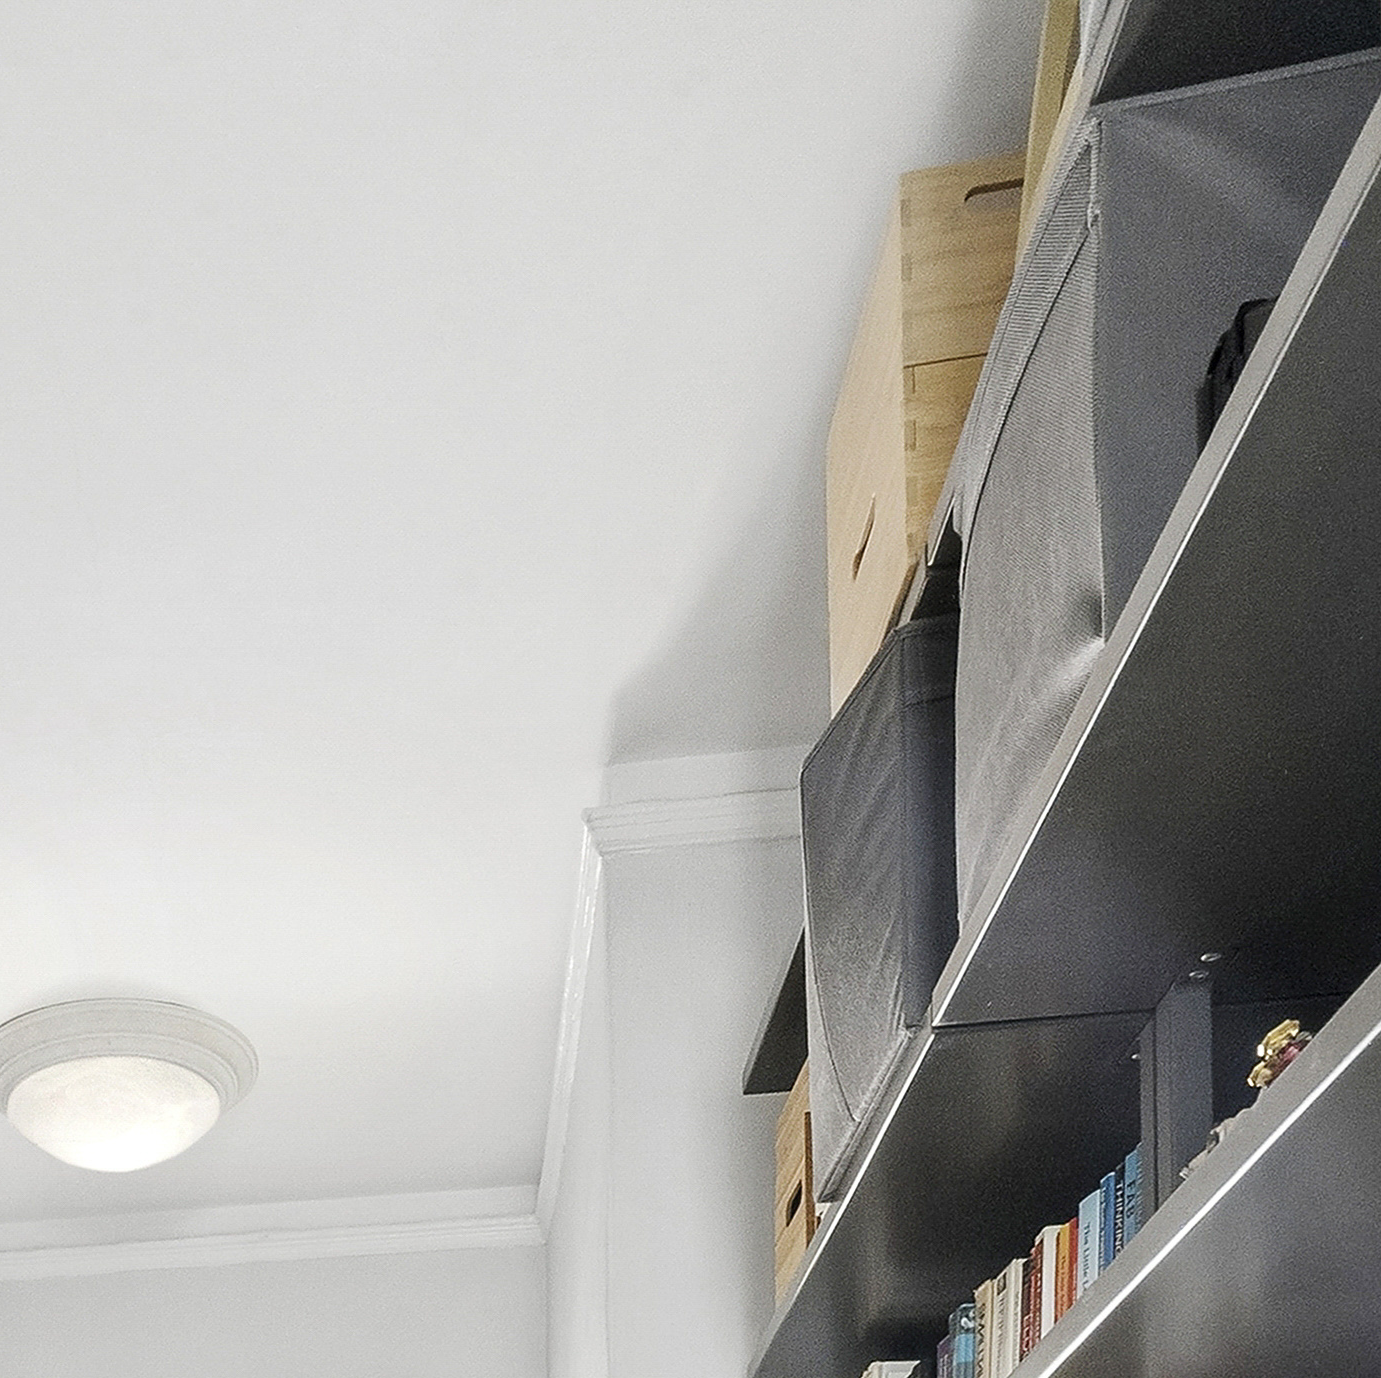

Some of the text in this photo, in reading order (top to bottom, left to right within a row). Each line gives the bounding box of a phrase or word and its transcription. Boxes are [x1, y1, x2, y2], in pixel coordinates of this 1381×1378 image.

[1126, 1180, 1136, 1219] FAB
[1082, 1222, 1091, 1278] The Little
